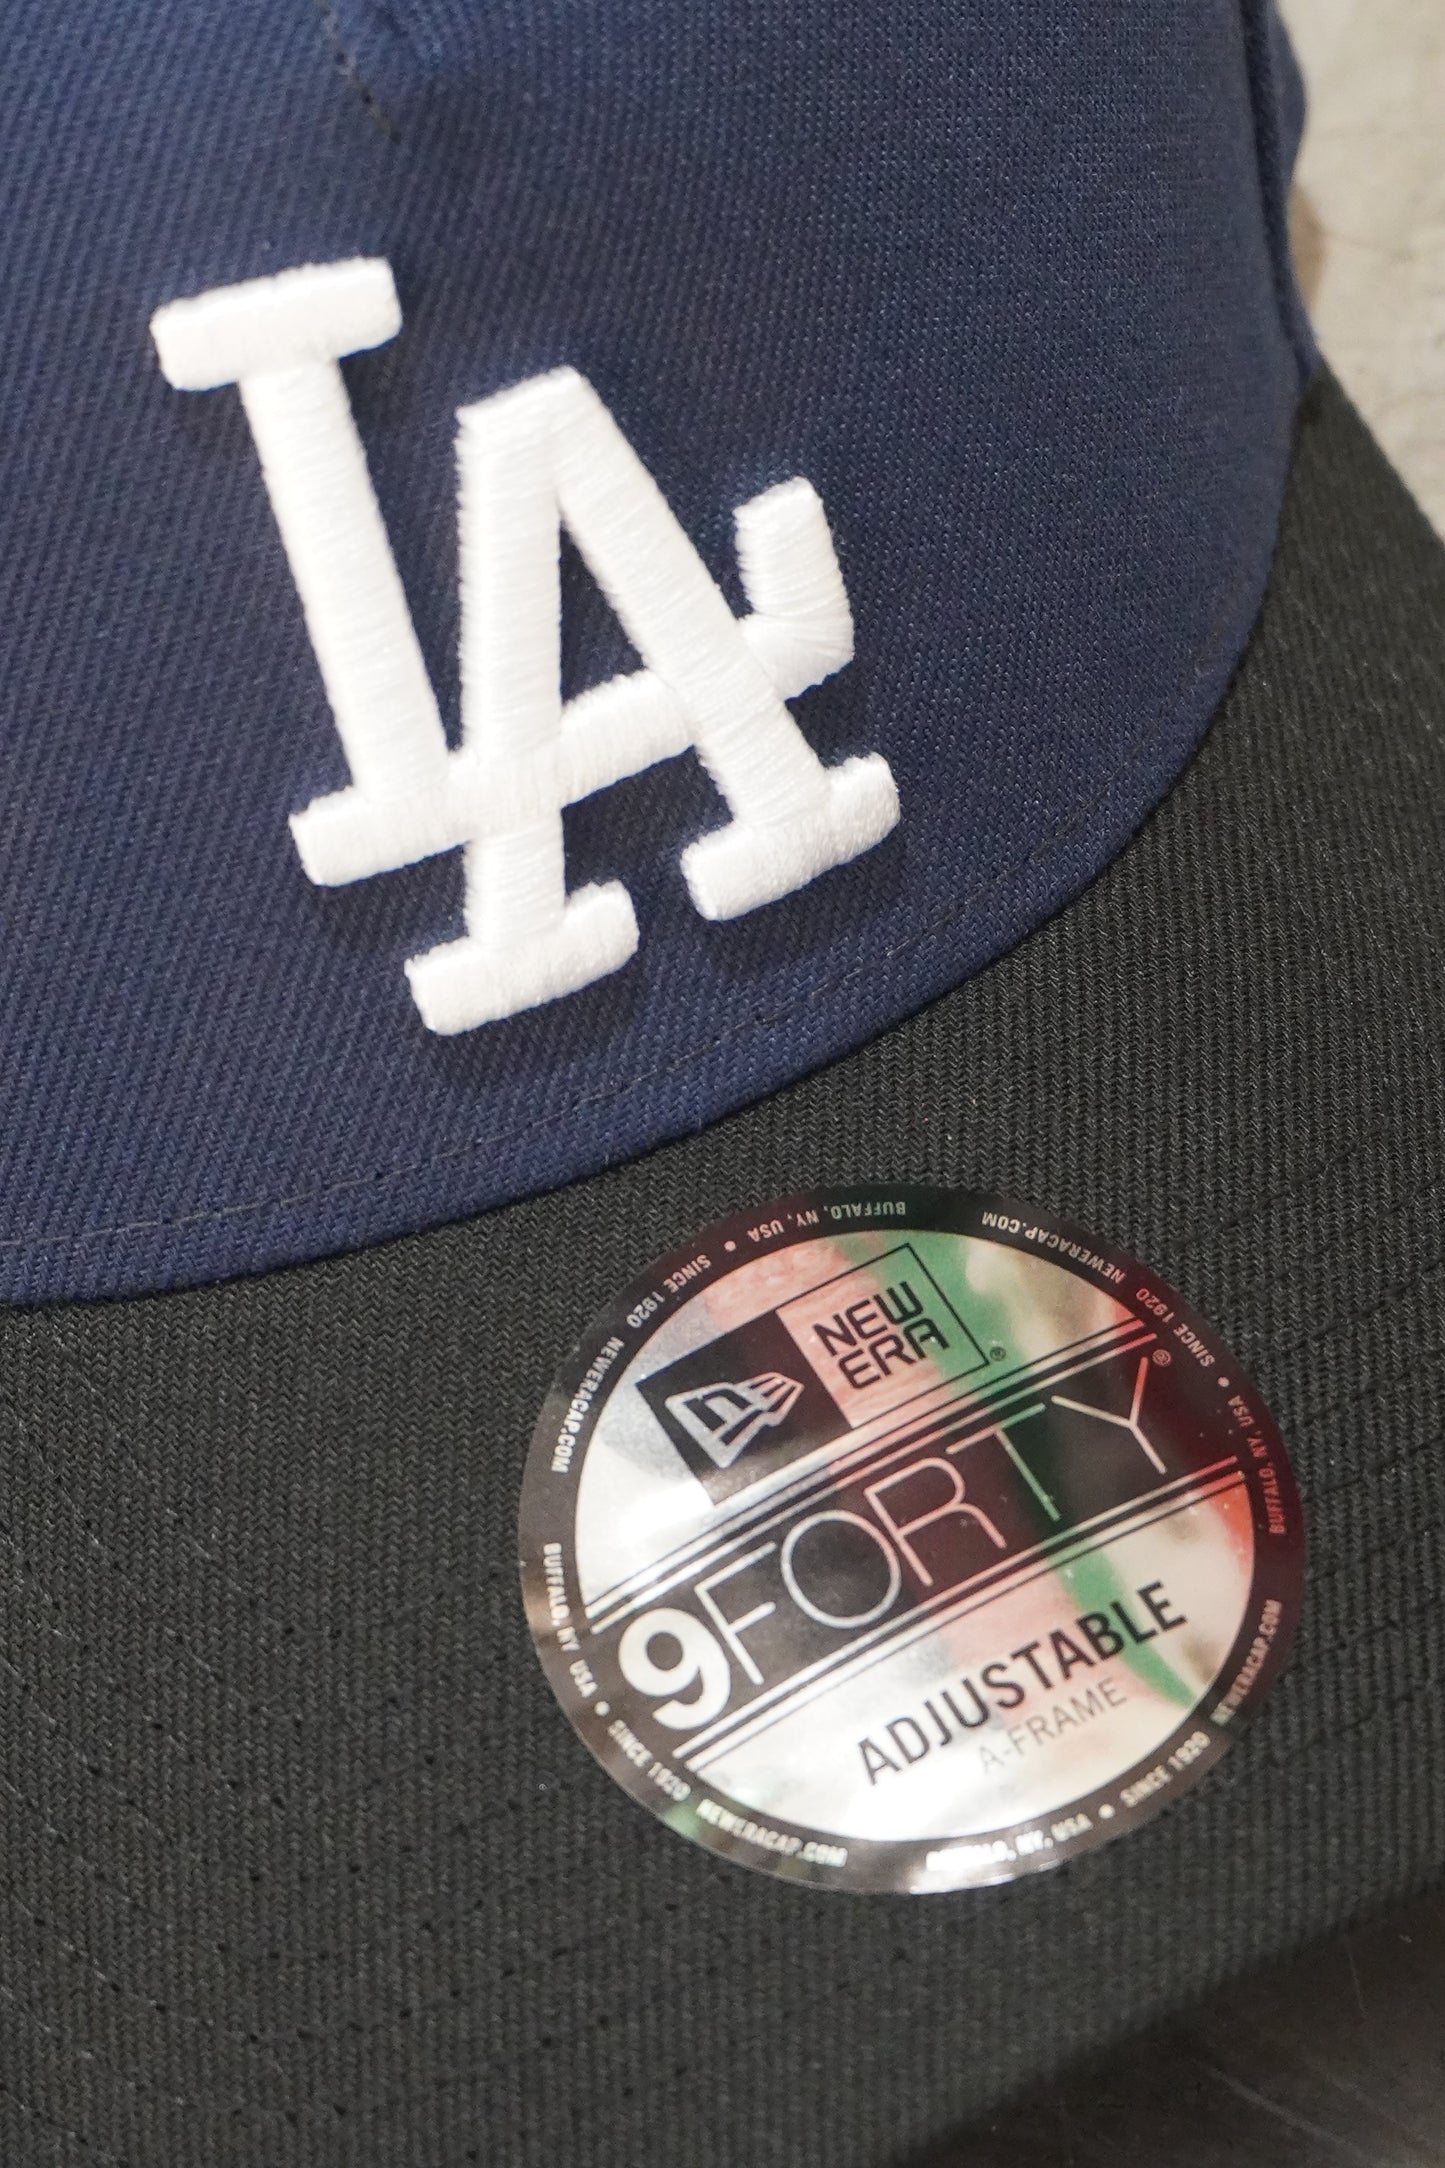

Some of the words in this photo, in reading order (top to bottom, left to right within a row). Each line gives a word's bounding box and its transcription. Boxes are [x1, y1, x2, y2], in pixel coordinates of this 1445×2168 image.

[150, 256, 901, 1036] LA
[747, 1219, 785, 1242] USA
[823, 1201, 906, 1220] BUFFALO,
[663, 1254, 711, 1293] SINCE
[981, 1211, 1126, 1284] NEWERACAP.COM
[626, 1291, 665, 1329] 1920
[812, 1281, 924, 1357] NEW
[1135, 1287, 1175, 1323] 1920
[838, 1317, 950, 1389] ERA
[1173, 1323, 1216, 1367] SINCE
[552, 1336, 625, 1473] NEWERACAP.COM
[1228, 1395, 1254, 1427] USA
[618, 1356, 1167, 1731] 9FORTY
[856, 1581, 1188, 1786] ADJUSTABLE
[569, 1659, 598, 1698] USA
[607, 1719, 653, 1768] SINCE
[648, 1762, 691, 1800] 1920
[977, 1677, 1129, 1778] A-FRAME
[1120, 1765, 1173, 1807] SINCE
